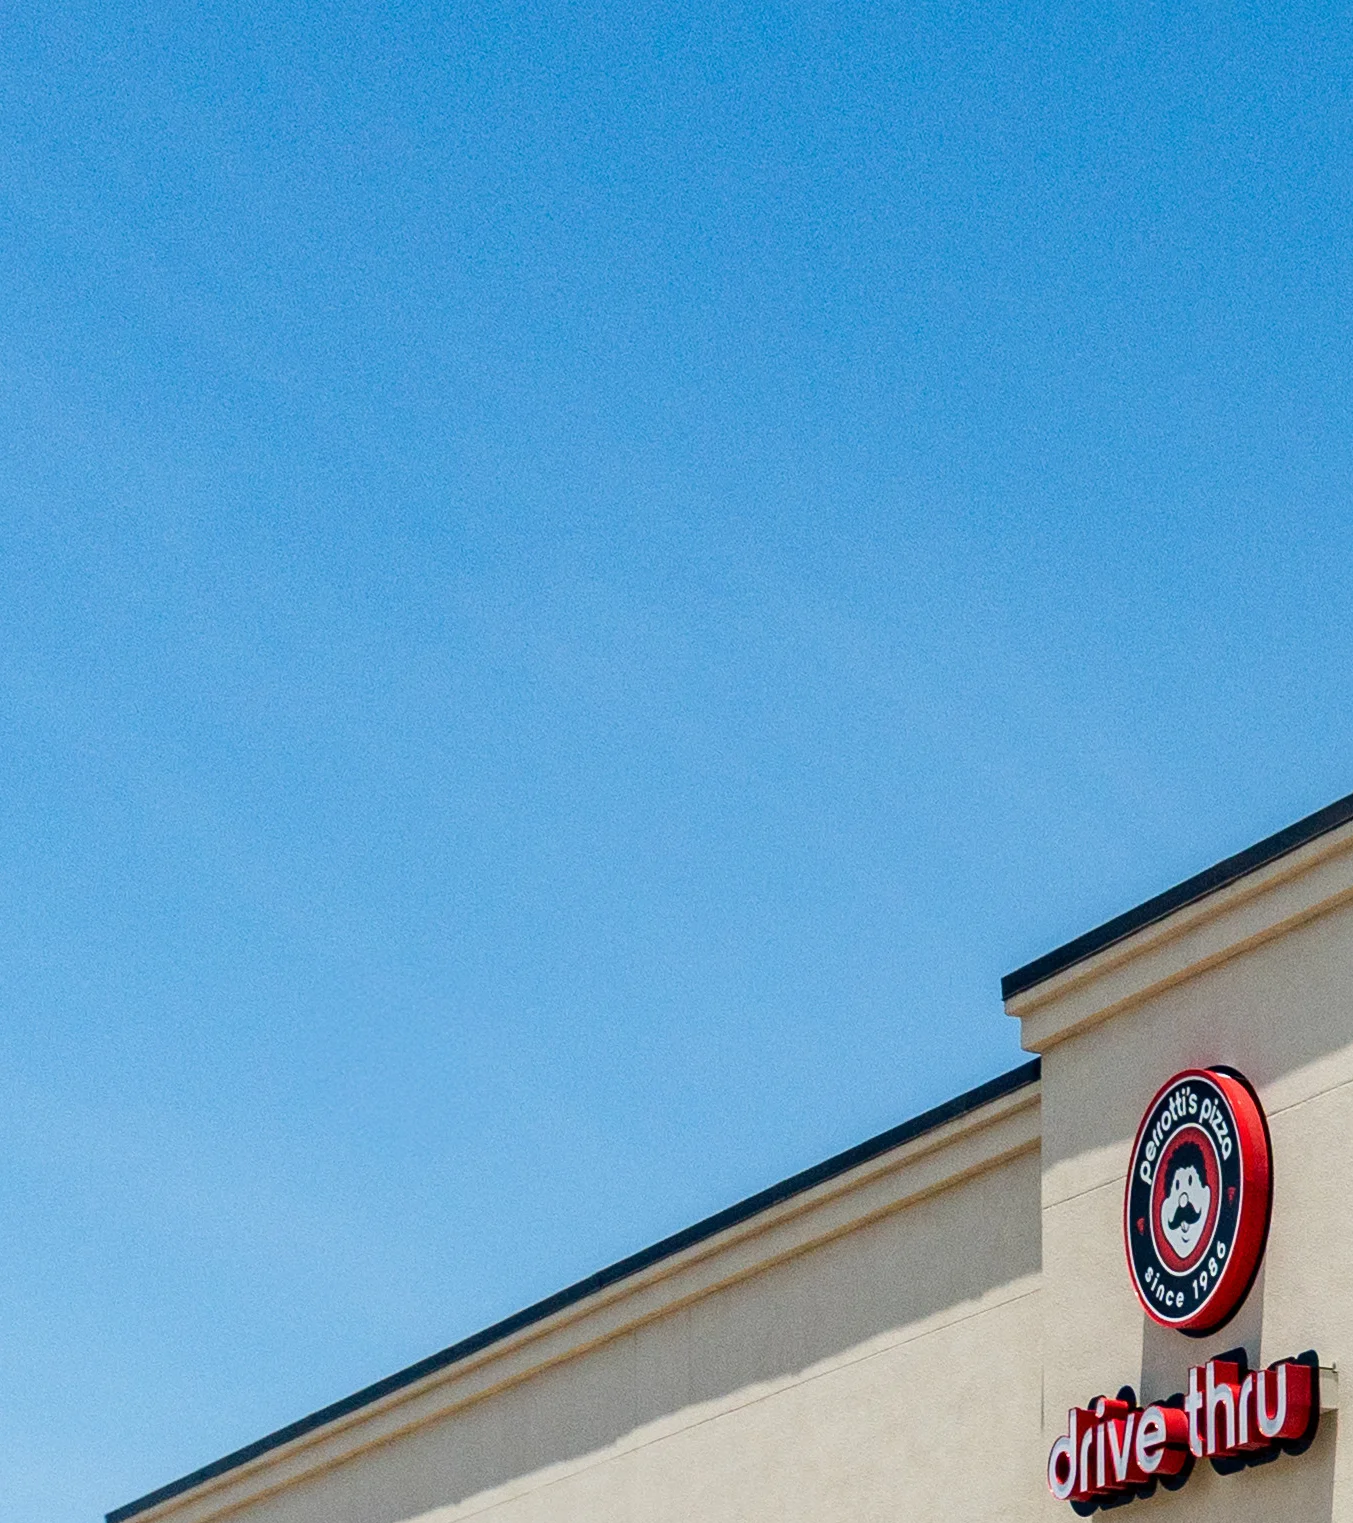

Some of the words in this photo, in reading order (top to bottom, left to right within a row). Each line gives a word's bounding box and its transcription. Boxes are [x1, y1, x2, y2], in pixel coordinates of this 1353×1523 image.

[1140, 1086, 1198, 1184] perrotti's
[1200, 1097, 1233, 1162] pizza
[1144, 1266, 1185, 1308] since
[1191, 1240, 1227, 1300] 1986
[1048, 1397, 1168, 1500] drive
[1185, 1360, 1288, 1458] thru
